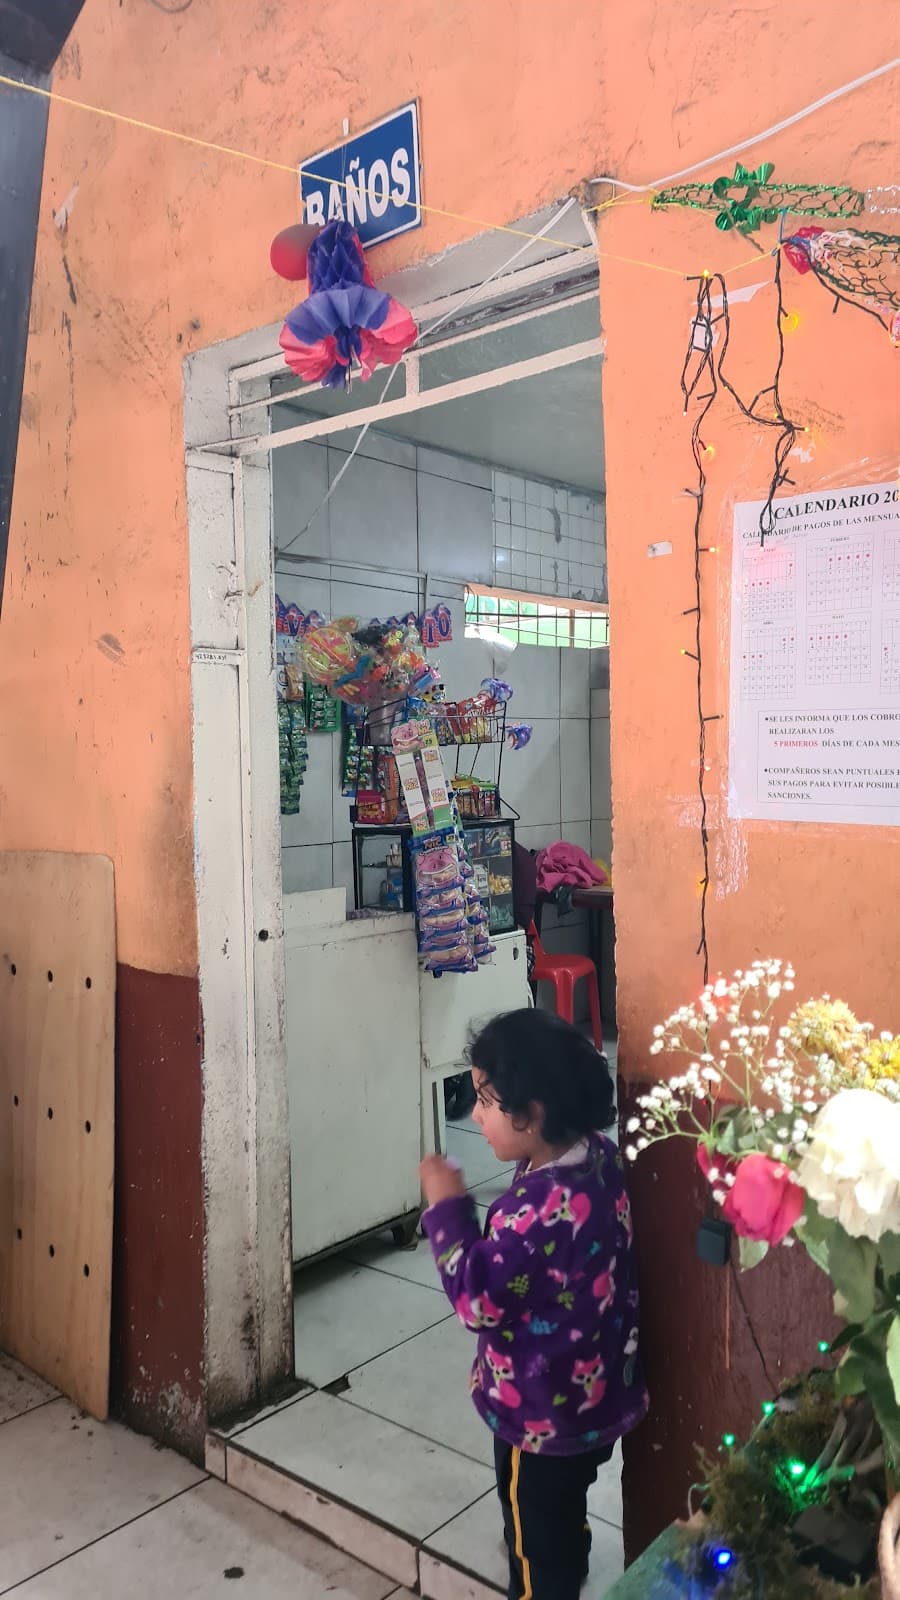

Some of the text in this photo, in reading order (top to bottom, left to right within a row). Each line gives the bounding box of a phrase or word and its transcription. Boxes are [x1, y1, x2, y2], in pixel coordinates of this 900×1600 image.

[306, 147, 411, 226] BAÑOS
[774, 493, 879, 520] CALENDARIO
[791, 524, 803, 532] DE
[804, 521, 831, 531] PAGOS
[833, 519, 843, 527] DE
[846, 517, 862, 525] LAS
[832, 714, 850, 722] QUE
[852, 713, 868, 721] LOS
[822, 739, 841, 748] DÍAS
[843, 740, 855, 748] DE
[768, 766, 821, 775] COMPAÑEROS
[846, 768, 895, 776] PUNTUALES
[810, 780, 831, 788] PARA
